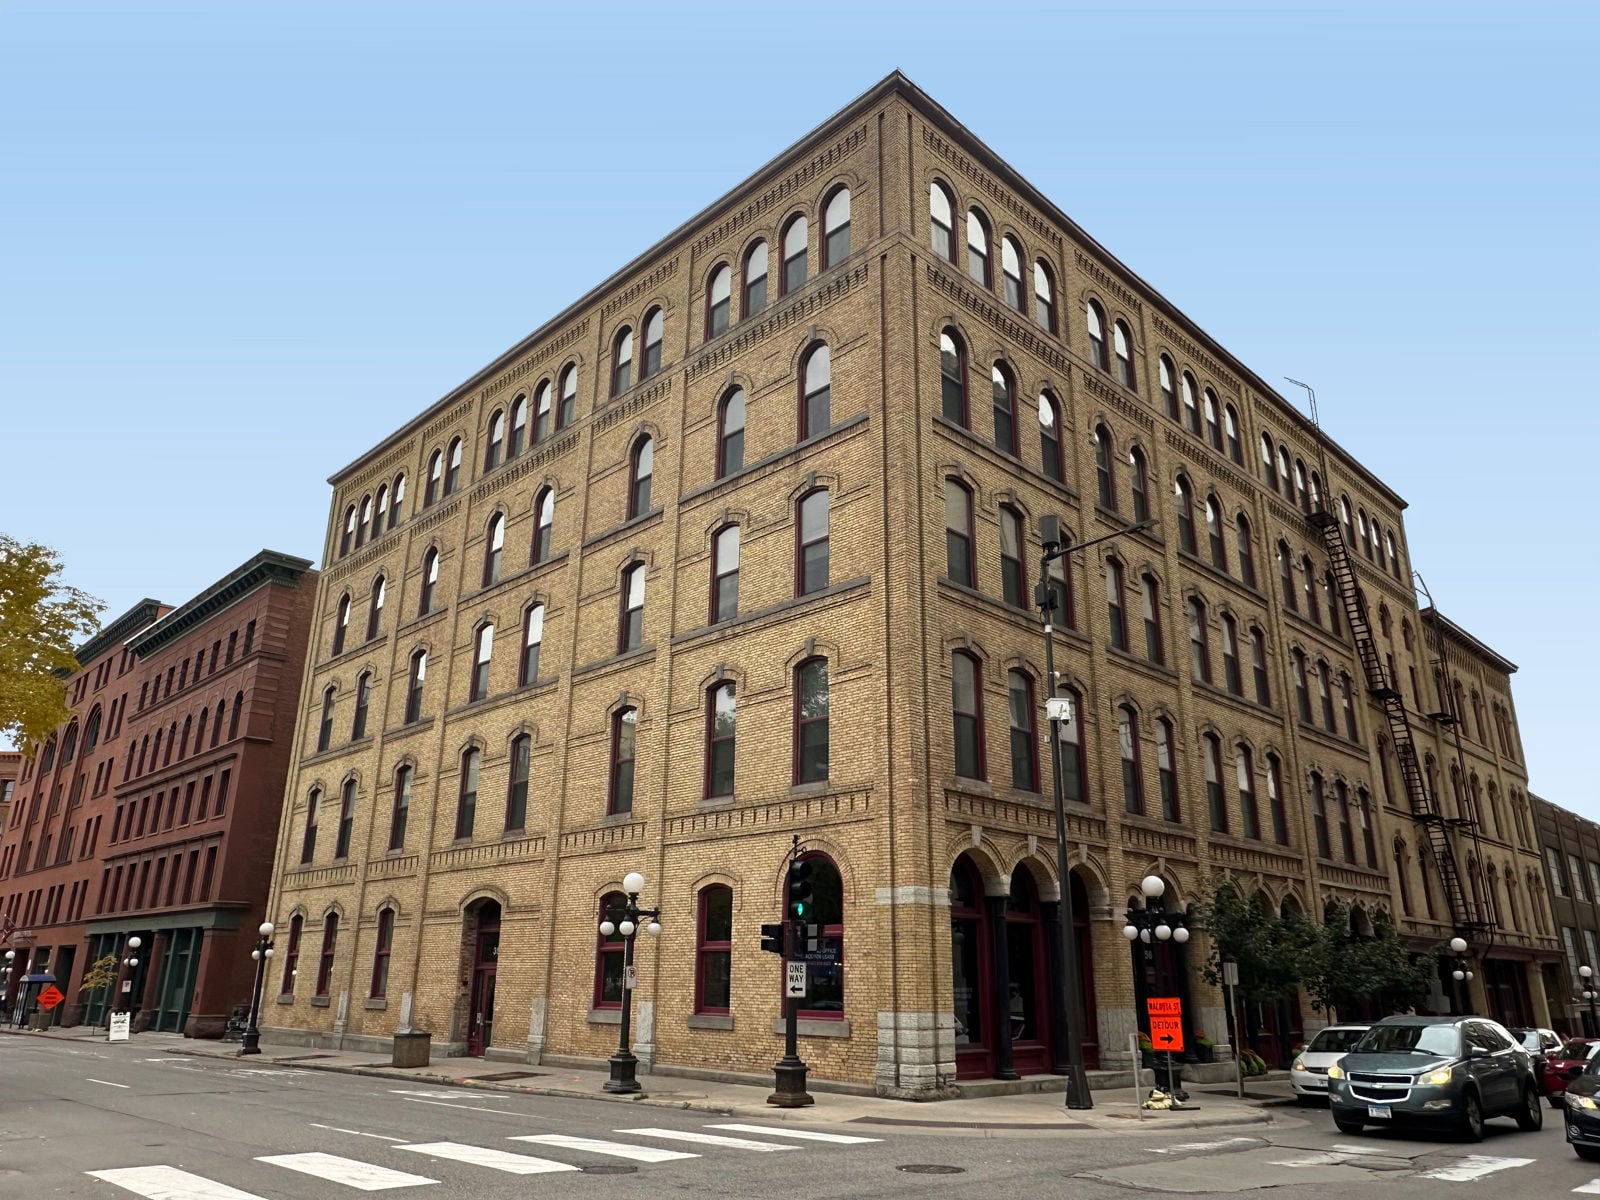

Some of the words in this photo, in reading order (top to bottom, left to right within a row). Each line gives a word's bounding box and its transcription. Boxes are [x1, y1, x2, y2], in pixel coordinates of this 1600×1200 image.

[789, 965, 804, 973] ONE
[789, 975, 804, 983] WAY
[1153, 1021, 1179, 1030] DETOUR
